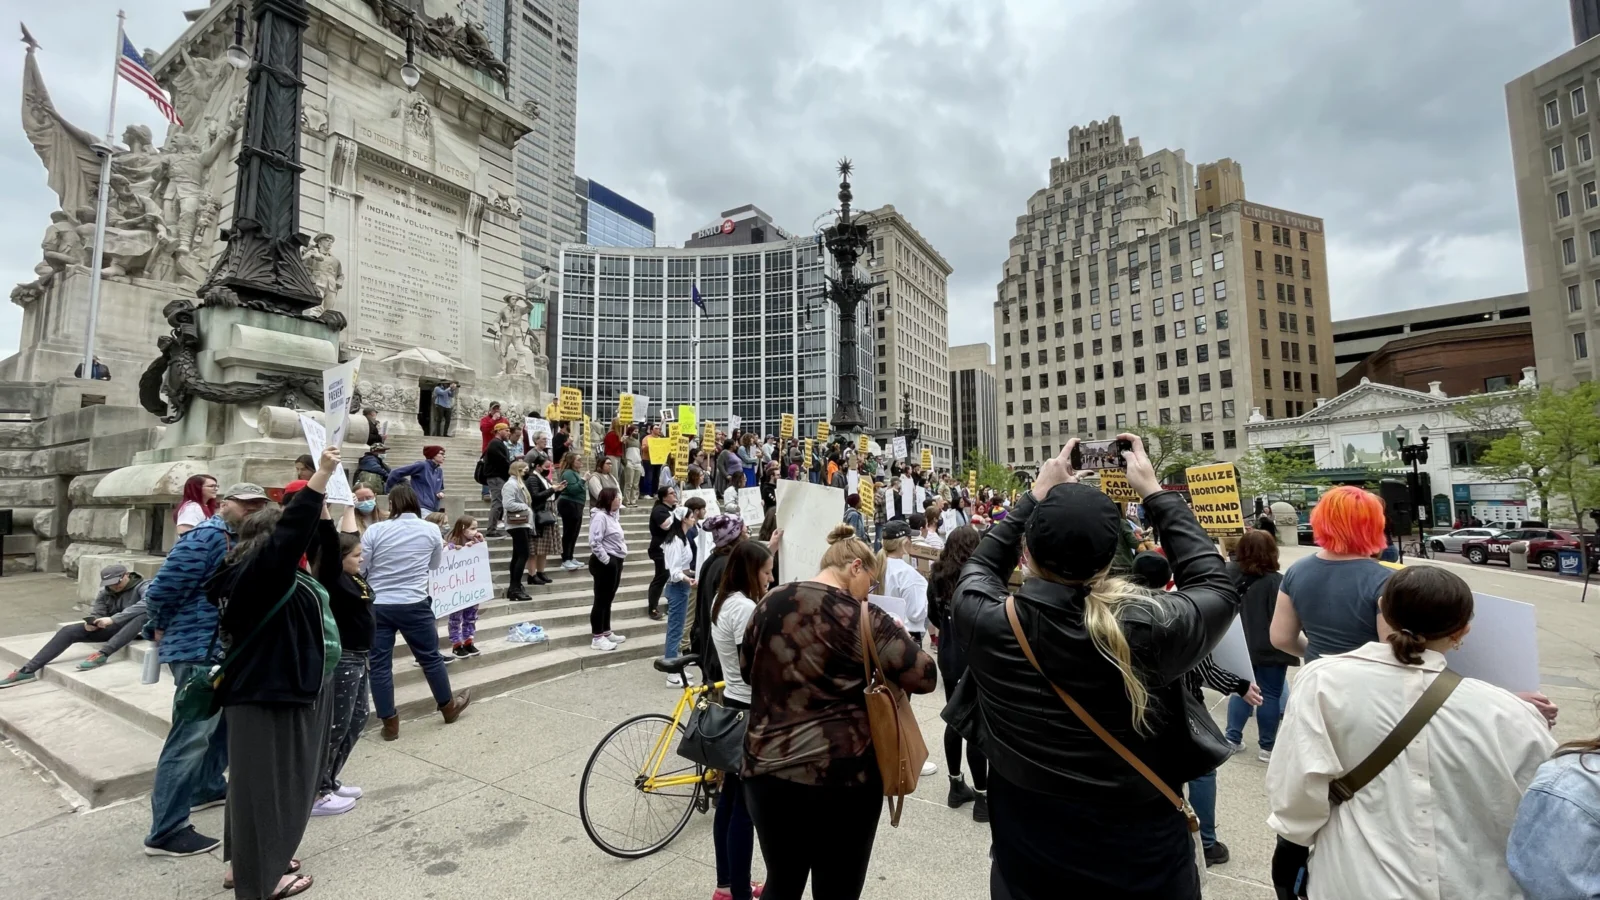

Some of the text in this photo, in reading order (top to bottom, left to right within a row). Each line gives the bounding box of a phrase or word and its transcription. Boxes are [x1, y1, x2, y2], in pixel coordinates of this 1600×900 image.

[363, 174, 385, 188] WAR
[388, 184, 407, 196] FOR
[431, 201, 457, 215] UNION
[367, 205, 454, 240] INDIANA VOLUNTEERS
[1244, 206, 1320, 231] CIRCLE TOWER
[698, 225, 721, 239] BMO
[1187, 470, 1233, 483] LEGALIZE
[1106, 488, 1137, 496] NOW!
[1191, 484, 1235, 496] ABORTION
[1194, 502, 1239, 512] ONCE AND
[1198, 514, 1240, 524] FOR ALL!
[1488, 543, 1510, 553] NEW
[1561, 556, 1578, 569] Indy
[433, 567, 475, 596] Pro-Child
[434, 588, 485, 614] Pro-Choice
